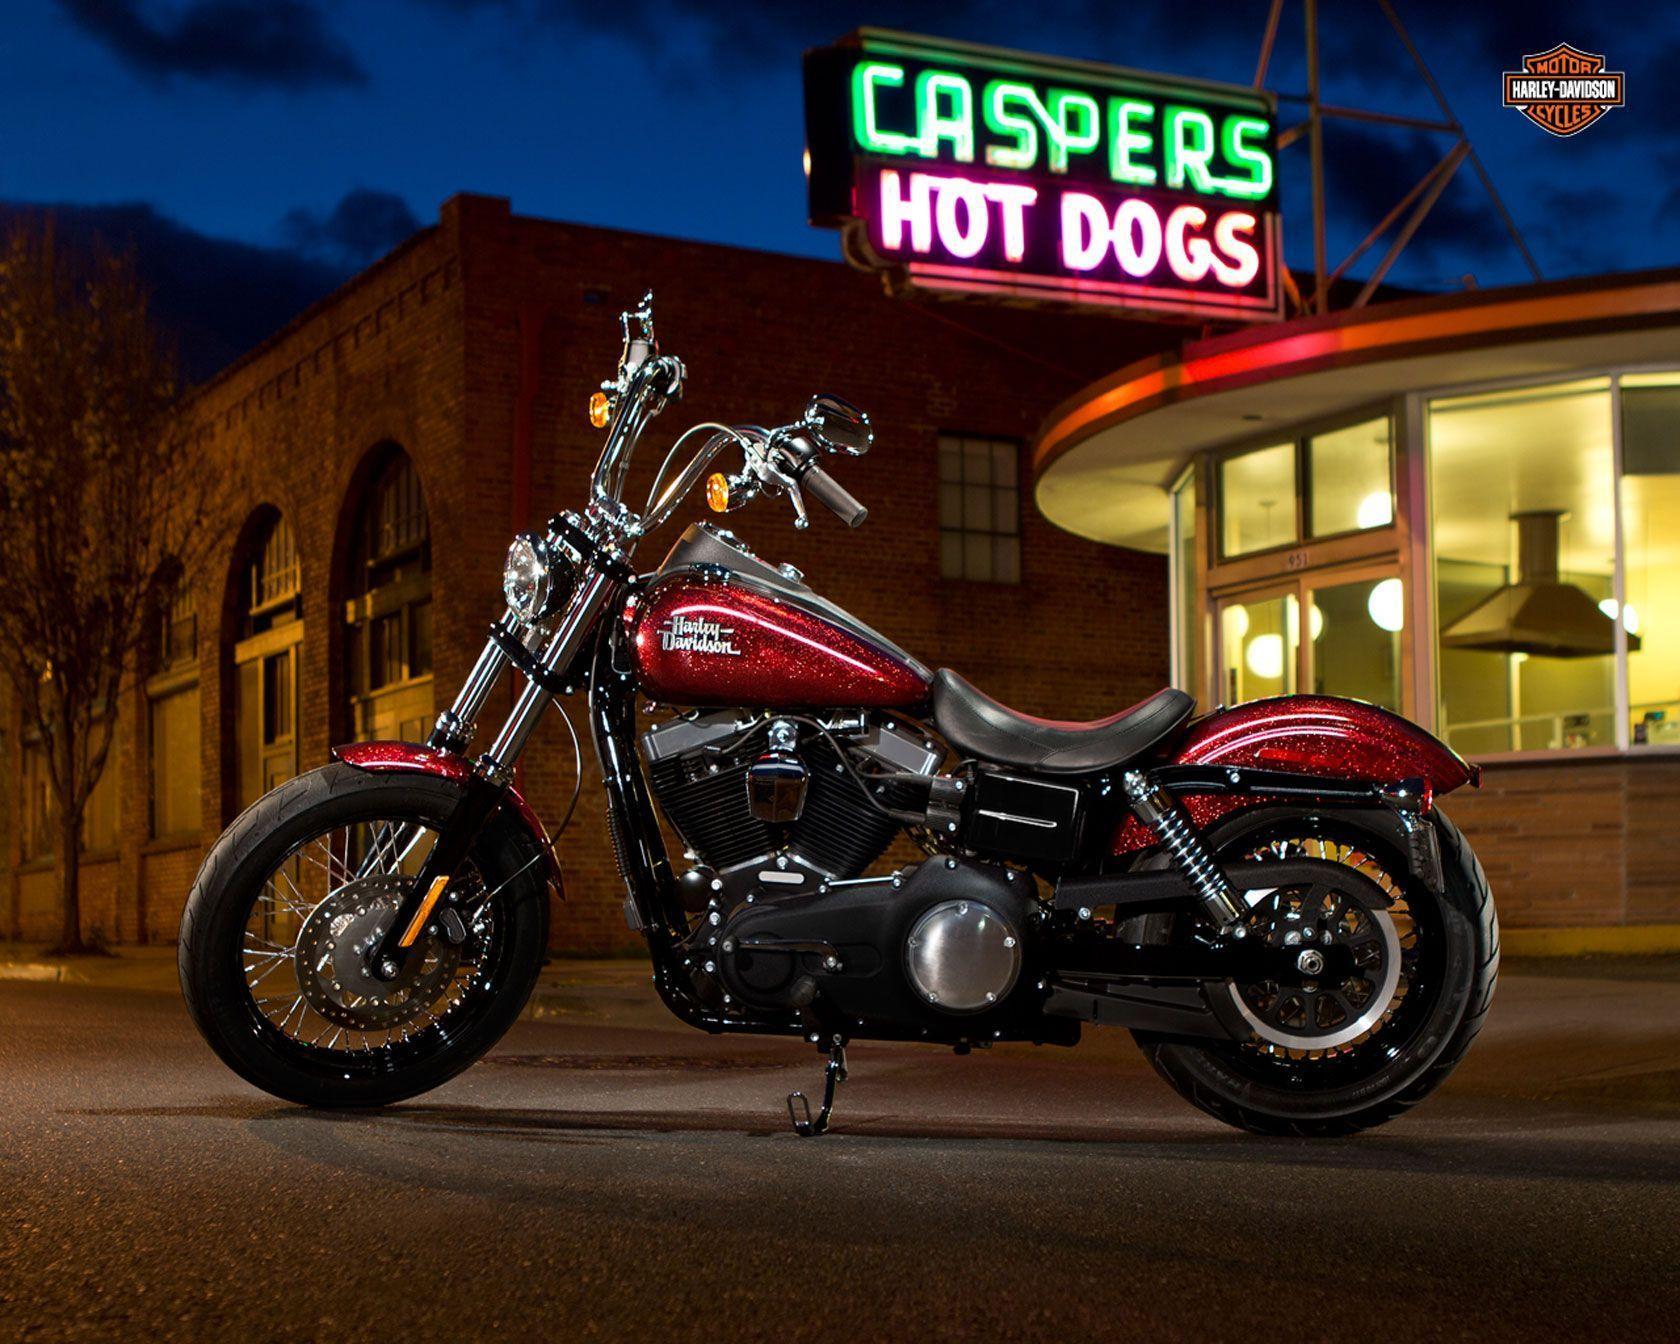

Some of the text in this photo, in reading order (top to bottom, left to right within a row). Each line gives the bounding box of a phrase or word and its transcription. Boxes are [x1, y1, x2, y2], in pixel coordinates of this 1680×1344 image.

[852, 60, 1273, 200] CASPERS
[880, 168, 1260, 288] HOT DOGS
[657, 630, 741, 656] Davidson
